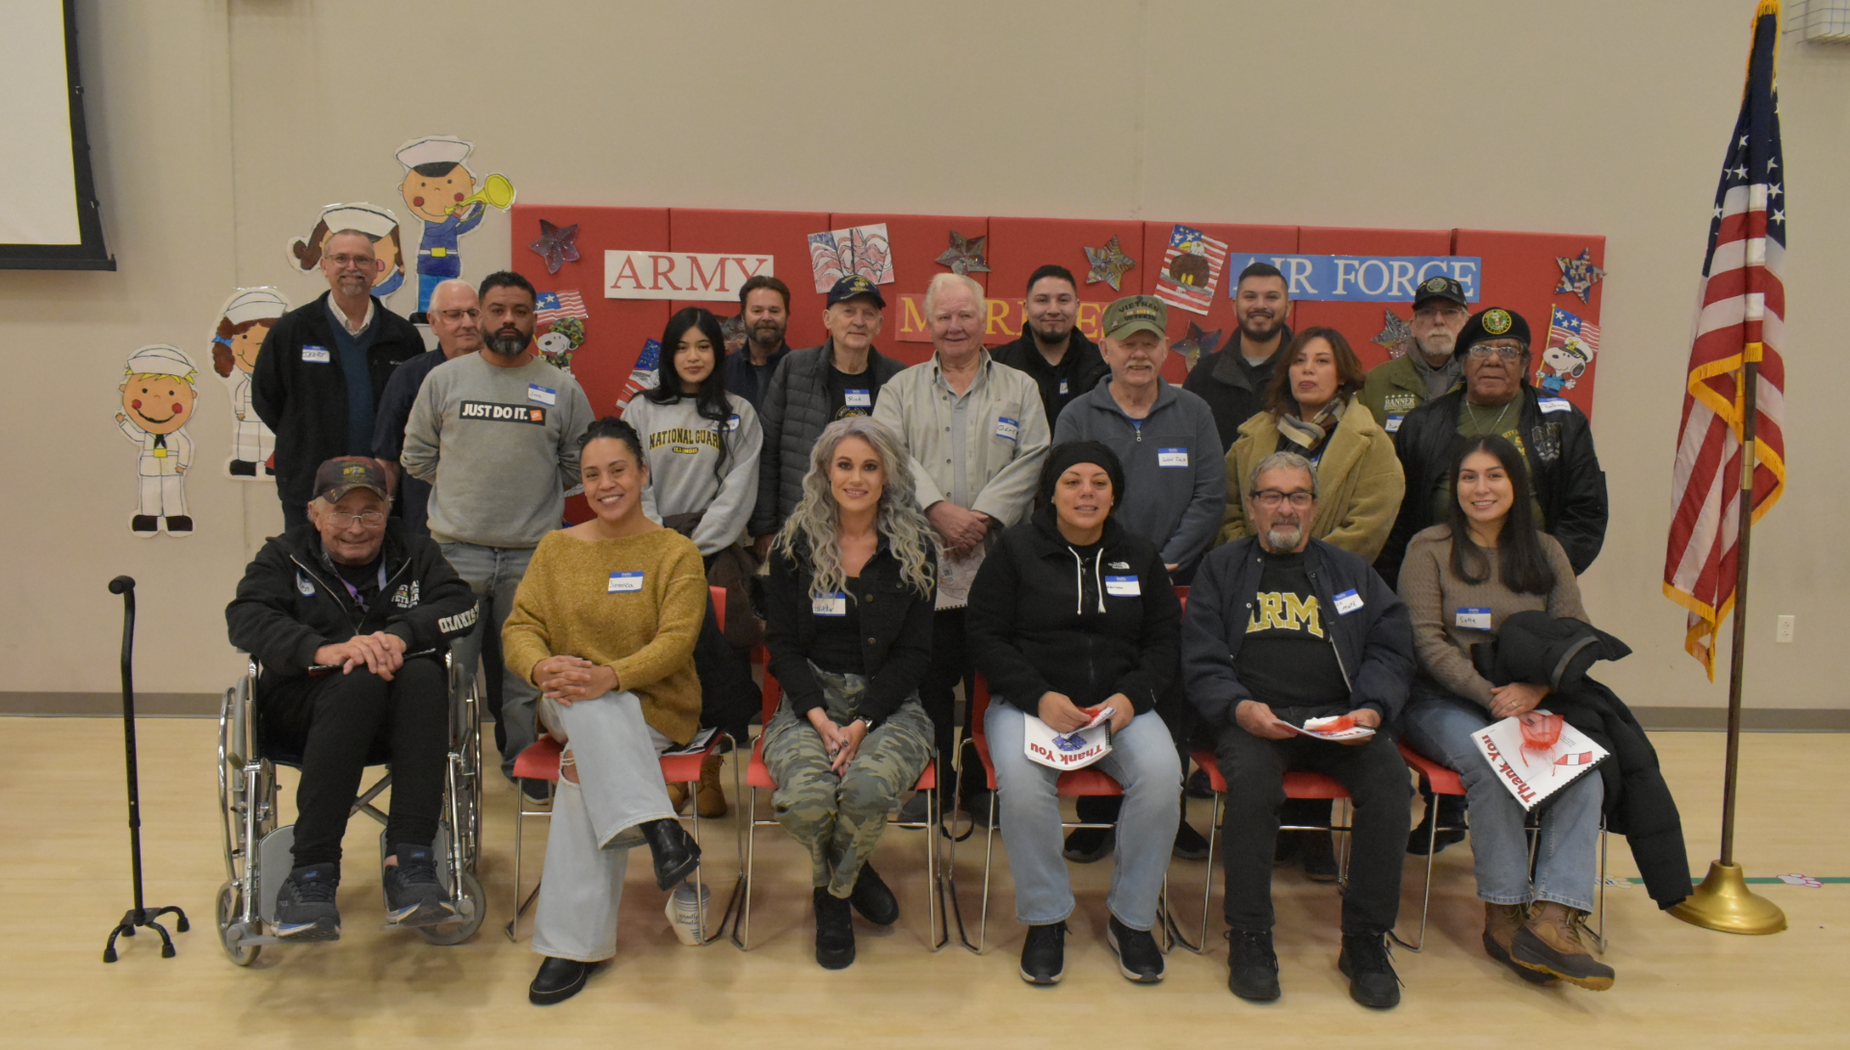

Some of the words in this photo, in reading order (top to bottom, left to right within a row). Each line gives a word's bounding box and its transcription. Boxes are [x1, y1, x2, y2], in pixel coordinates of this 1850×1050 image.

[610, 254, 768, 293] ARMY
[1332, 259, 1477, 298] FORCE
[461, 403, 493, 418] JUST
[492, 405, 513, 419] DO
[513, 407, 529, 420] IT.
[649, 428, 695, 451] NATIONAL
[694, 429, 720, 451] GUAR
[438, 608, 477, 633] SERVED
[1246, 592, 1325, 638] RM
[1030, 742, 1056, 763] You
[1060, 744, 1103, 765] Thank
[1481, 734, 1501, 762] You
[1499, 760, 1537, 804] Thank
